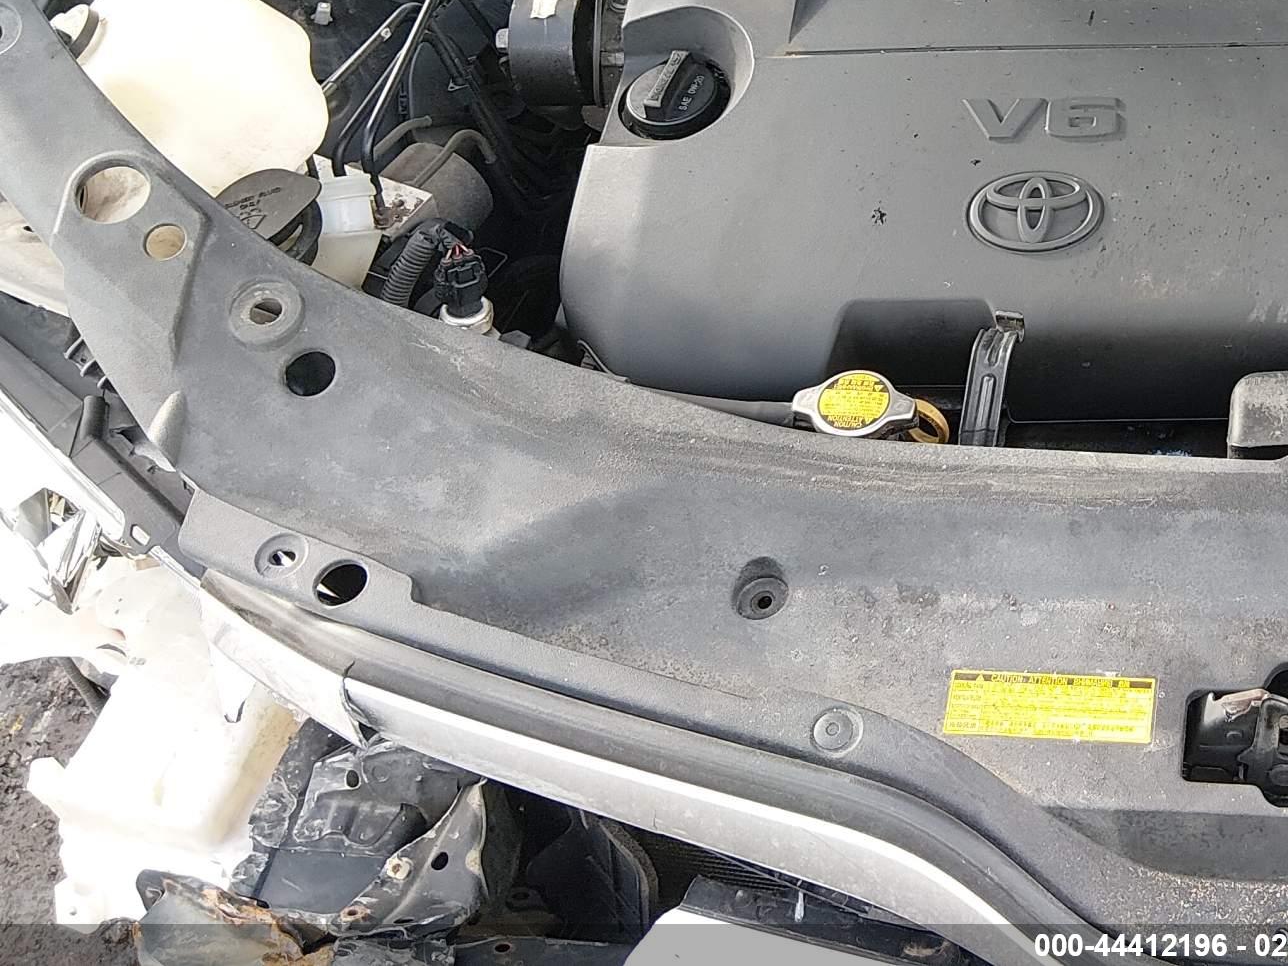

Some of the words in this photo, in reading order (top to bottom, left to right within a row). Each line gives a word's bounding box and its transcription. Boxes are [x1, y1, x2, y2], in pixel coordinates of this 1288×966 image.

[678, 96, 693, 111] SAE
[961, 97, 1124, 142] V6
[991, 674, 1022, 684] CAUTION
[1029, 675, 1068, 686] ATTENTION
